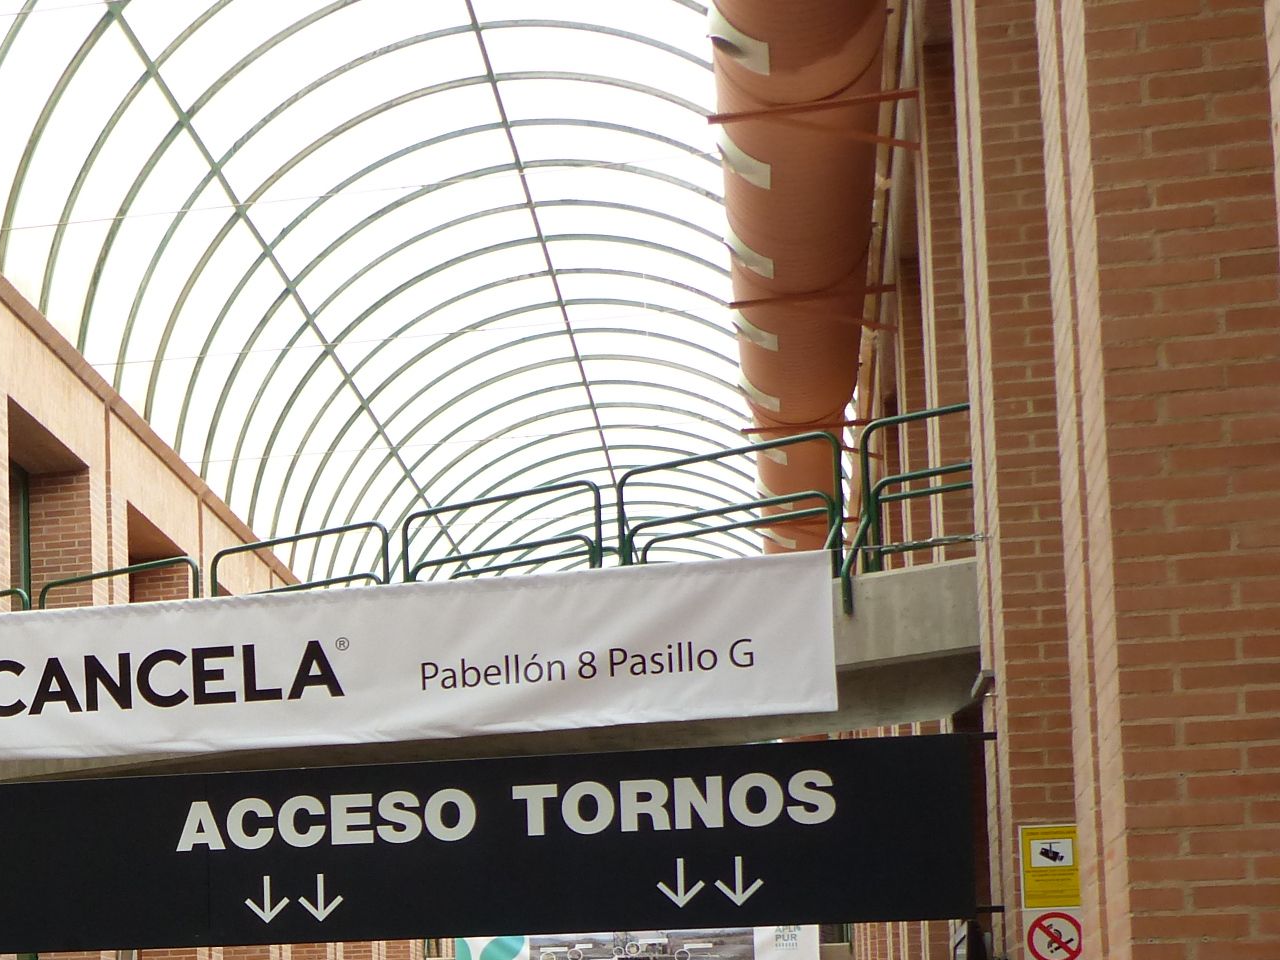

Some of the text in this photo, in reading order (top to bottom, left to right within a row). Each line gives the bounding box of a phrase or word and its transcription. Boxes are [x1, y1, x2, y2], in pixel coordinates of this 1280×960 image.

[421, 639, 753, 690] Pabellón 8 Pasillo G
[176, 770, 836, 851] ACCESO TORNOS
[775, 933, 797, 942] PUR
